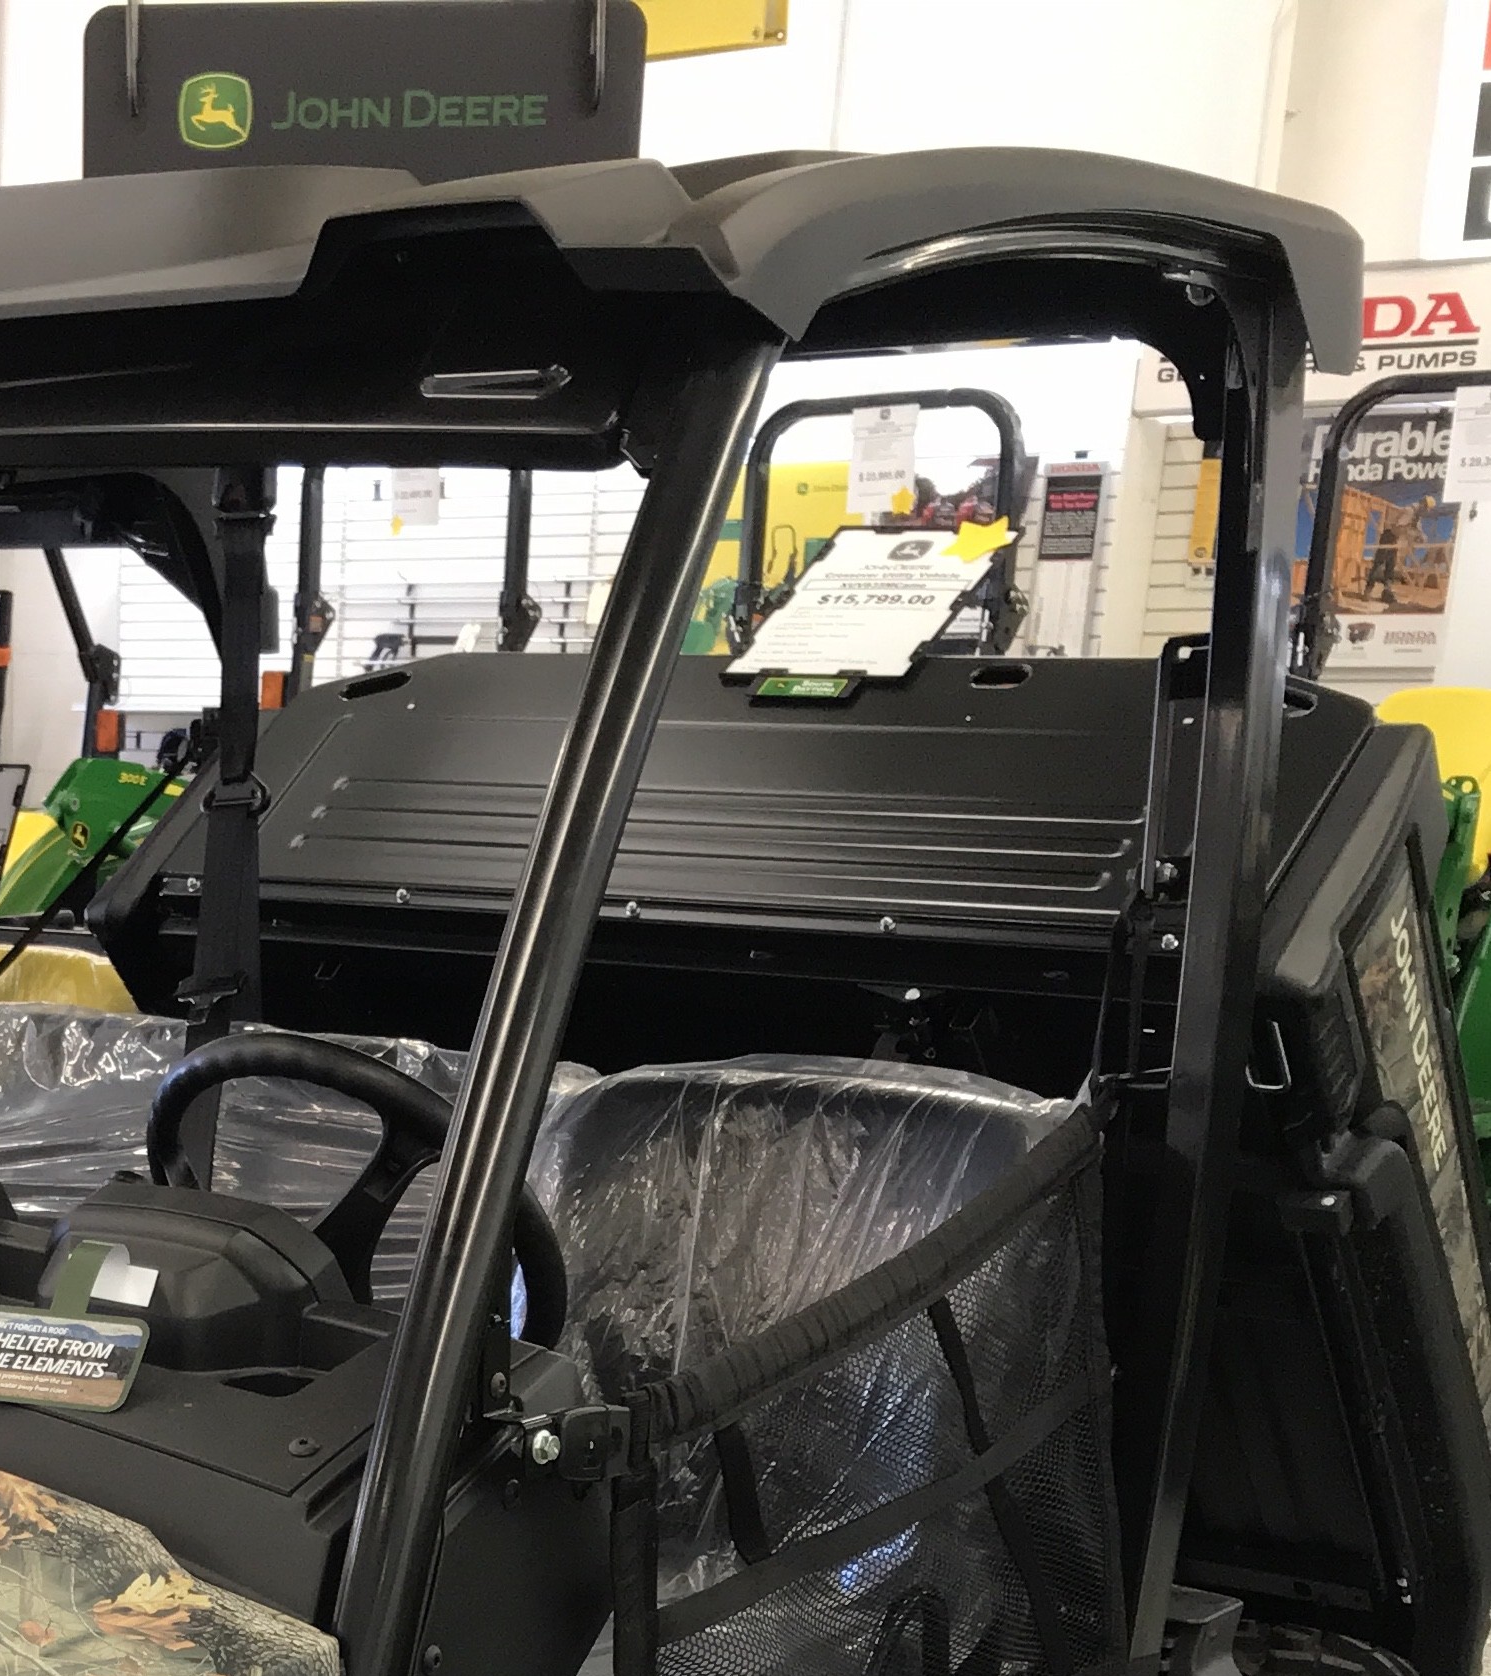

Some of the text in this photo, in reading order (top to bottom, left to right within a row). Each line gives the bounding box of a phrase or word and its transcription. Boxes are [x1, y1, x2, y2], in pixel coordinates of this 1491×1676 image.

[271, 89, 548, 129] JOHN DEERE
[1377, 350, 1477, 371] PUMPS
[817, 594, 936, 606] $15,799.00
[1390, 907, 1447, 1172] JOHN DEERE
[14, 1323, 42, 1332] FORGET
[58, 1340, 114, 1359] FROM
[12, 1355, 109, 1378] ELEMENTS
